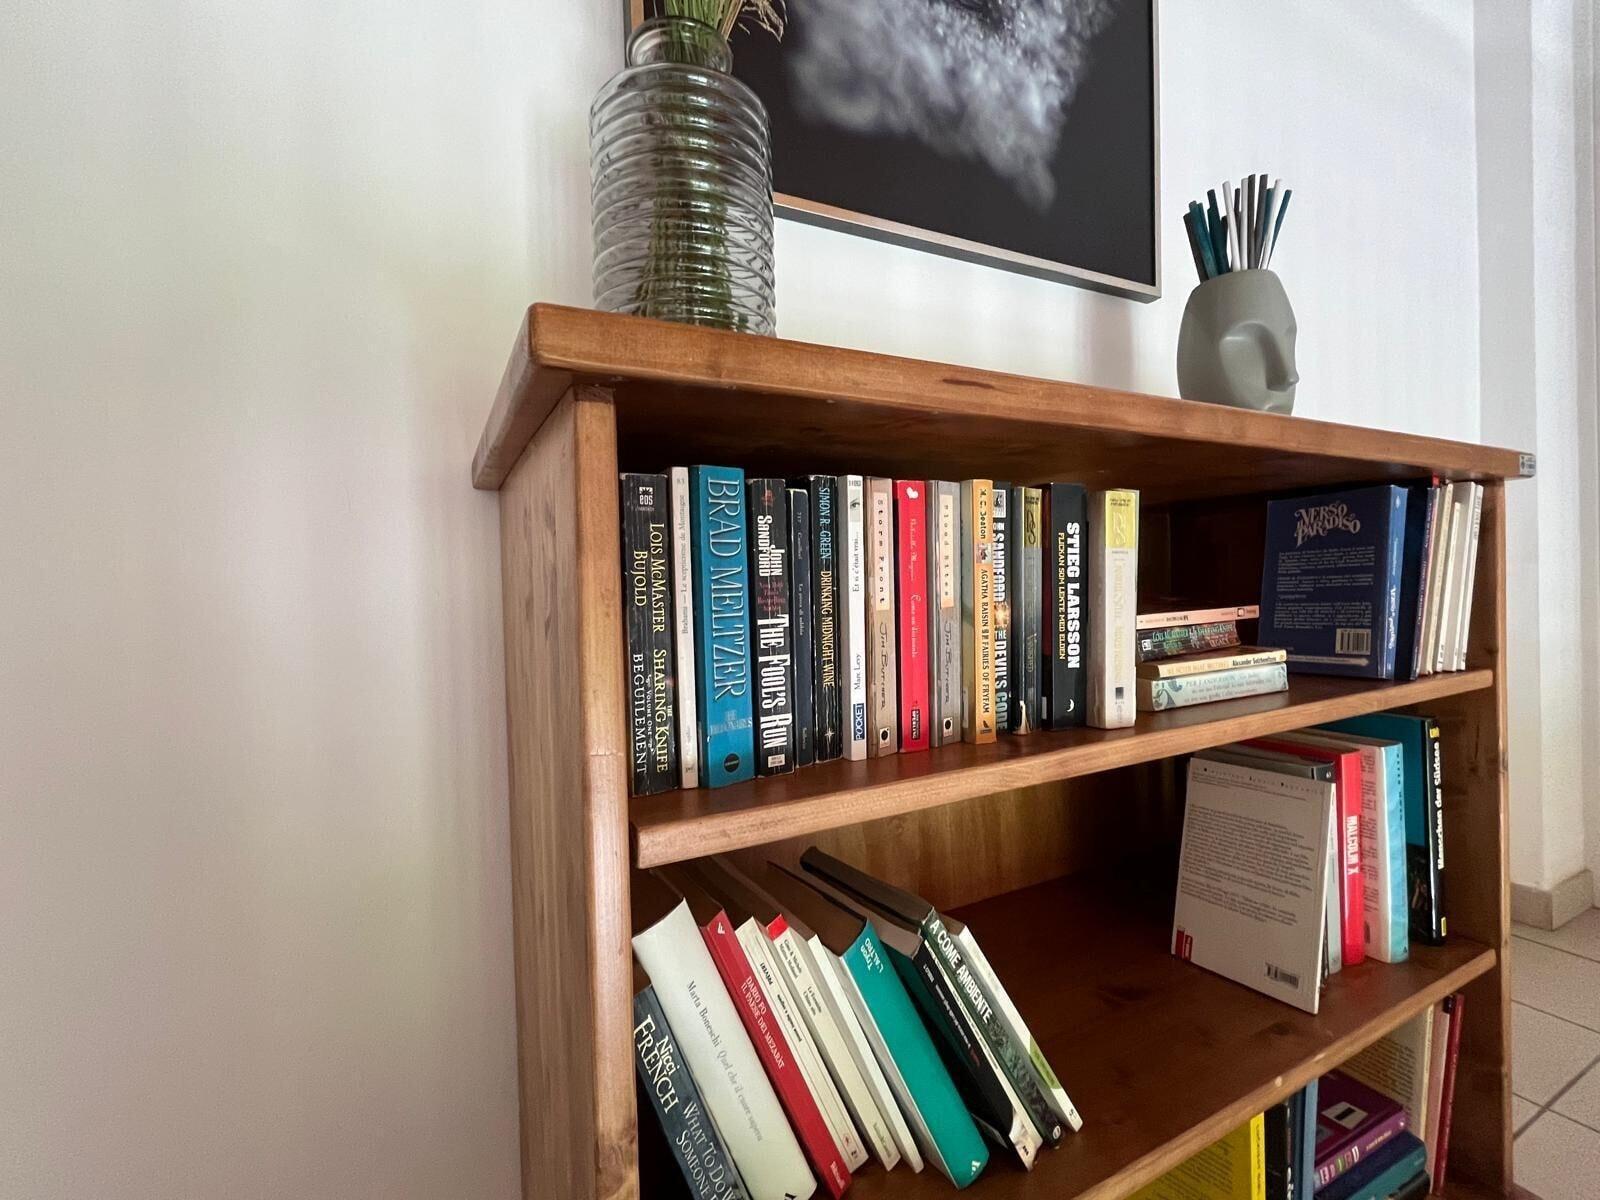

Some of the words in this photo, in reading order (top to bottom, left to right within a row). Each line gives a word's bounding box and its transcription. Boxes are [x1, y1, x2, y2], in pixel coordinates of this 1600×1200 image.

[818, 487, 831, 516] SIMON
[980, 489, 987, 498] M.
[708, 476, 742, 557] BRAD
[1294, 503, 1348, 526] VERSO
[757, 515, 773, 576] SANDFORD
[770, 544, 785, 576] JOHN
[820, 530, 832, 559] GREEN
[1066, 522, 1080, 578] STIEG
[630, 550, 648, 607] BUJOLD
[981, 569, 989, 599] AGATHA
[993, 533, 1005, 602] SANDFORD
[820, 570, 832, 615] DRINKING
[757, 614, 789, 649] THE
[982, 602, 990, 627] RAISIN
[1058, 614, 1066, 632] MED
[1066, 582, 1080, 669] LARSSON
[710, 565, 746, 703] MELTZER
[821, 617, 834, 661] MIDNIGHT
[995, 630, 1006, 640] THE
[1058, 633, 1066, 660] ELDEN
[853, 653, 861, 673] Levy
[982, 642, 990, 670] FAIRIES
[995, 641, 1007, 690] DEVIL'S
[653, 649, 667, 722] SHARING
[758, 654, 791, 709] FOOL'S
[823, 664, 835, 688] WINE
[853, 675, 861, 690] Marc
[982, 672, 990, 682] OF
[632, 654, 647, 774] BEGUILEMENT
[982, 684, 990, 713] FRYFAM
[995, 692, 1007, 729] CODE
[760, 712, 793, 749] RUN
[854, 703, 865, 741] POCKET
[655, 726, 669, 773] KNIFE
[1433, 742, 1443, 786] Südsee
[1434, 787, 1443, 808] der
[1346, 815, 1360, 865] MALCOLM
[1435, 808, 1445, 870] Menschen
[1347, 866, 1360, 876] X
[741, 982, 749, 994] IL
[929, 919, 940, 935] A
[937, 931, 962, 970] COME
[956, 964, 993, 1025] AMBIENTE
[744, 992, 760, 1020] PAESE
[745, 976, 761, 1006] DARIO
[757, 1004, 767, 1015] FO
[687, 980, 701, 1008] Marta
[699, 1007, 722, 1049] Boneschi
[716, 1050, 731, 1073] Quel
[728, 1068, 737, 1086] che
[757, 1016, 768, 1036] DEI
[633, 1013, 680, 1114] FRENCH
[683, 1100, 708, 1144] WHAT
